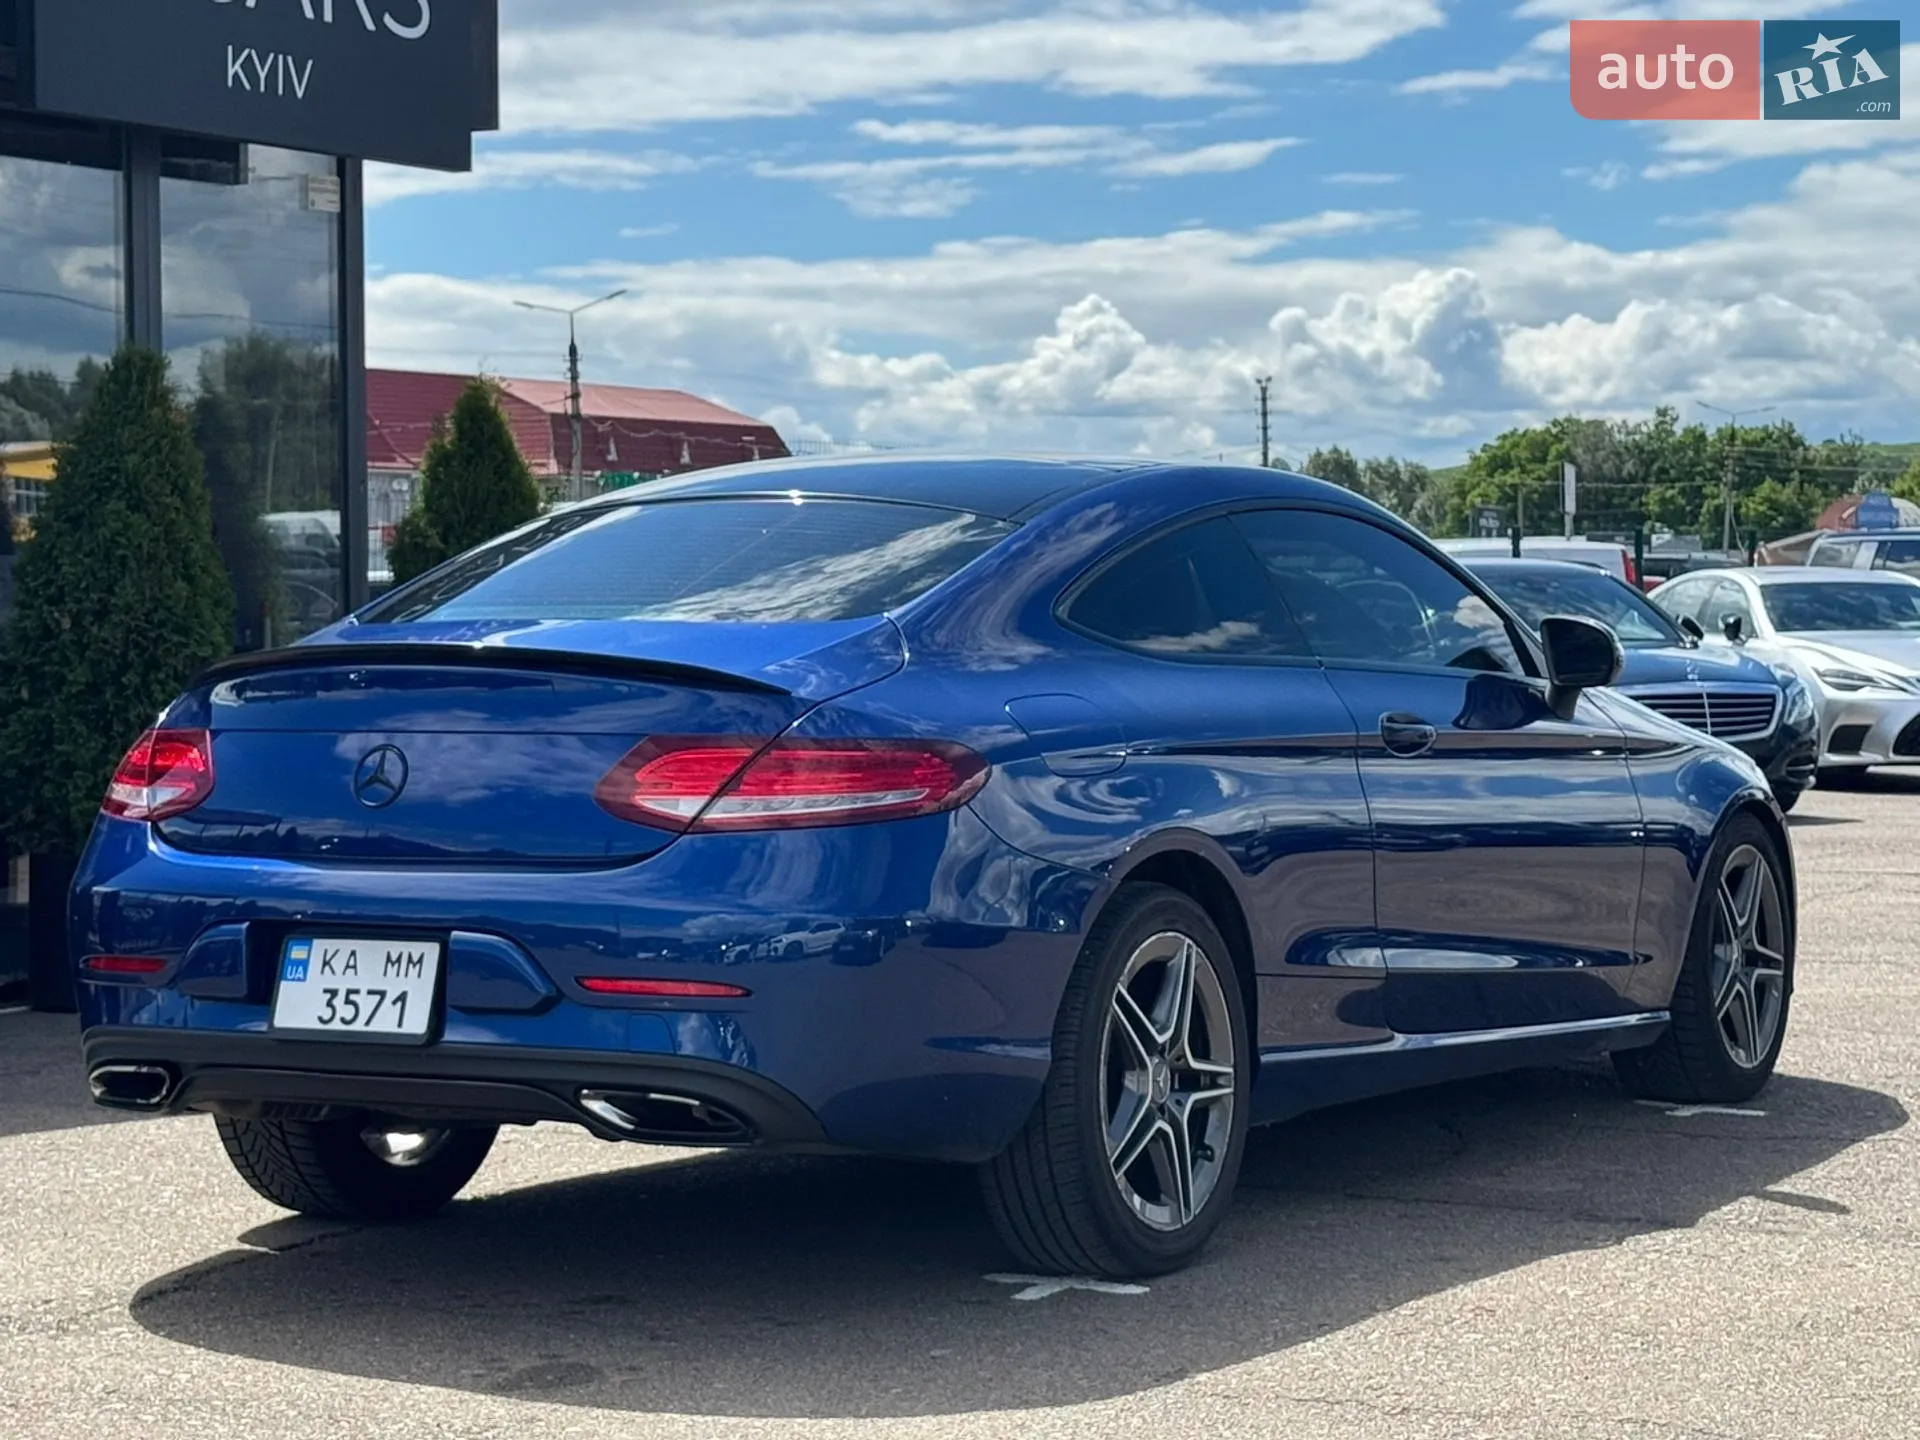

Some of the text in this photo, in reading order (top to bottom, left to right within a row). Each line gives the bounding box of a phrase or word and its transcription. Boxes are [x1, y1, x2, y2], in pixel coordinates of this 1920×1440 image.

[227, 45, 313, 99] KYIV
[286, 965, 304, 980] UA
[320, 948, 425, 979] KA MM
[317, 988, 408, 1029] 3571
